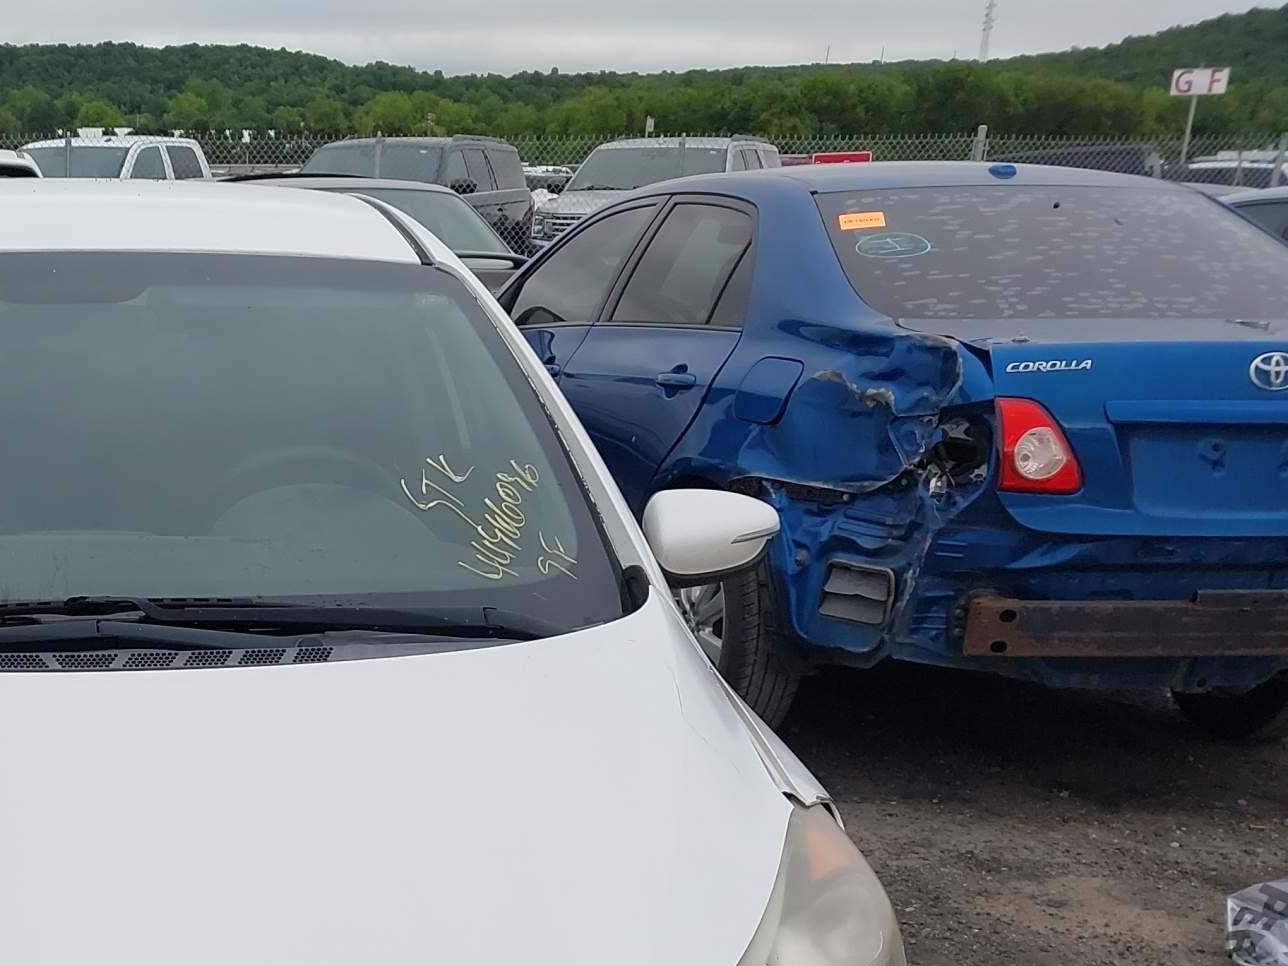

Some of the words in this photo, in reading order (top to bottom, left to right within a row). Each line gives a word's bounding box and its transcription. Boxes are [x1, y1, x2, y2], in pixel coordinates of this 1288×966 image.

[1175, 70, 1193, 93] G
[1208, 68, 1225, 93] F
[1006, 360, 1092, 373] COROLLA
